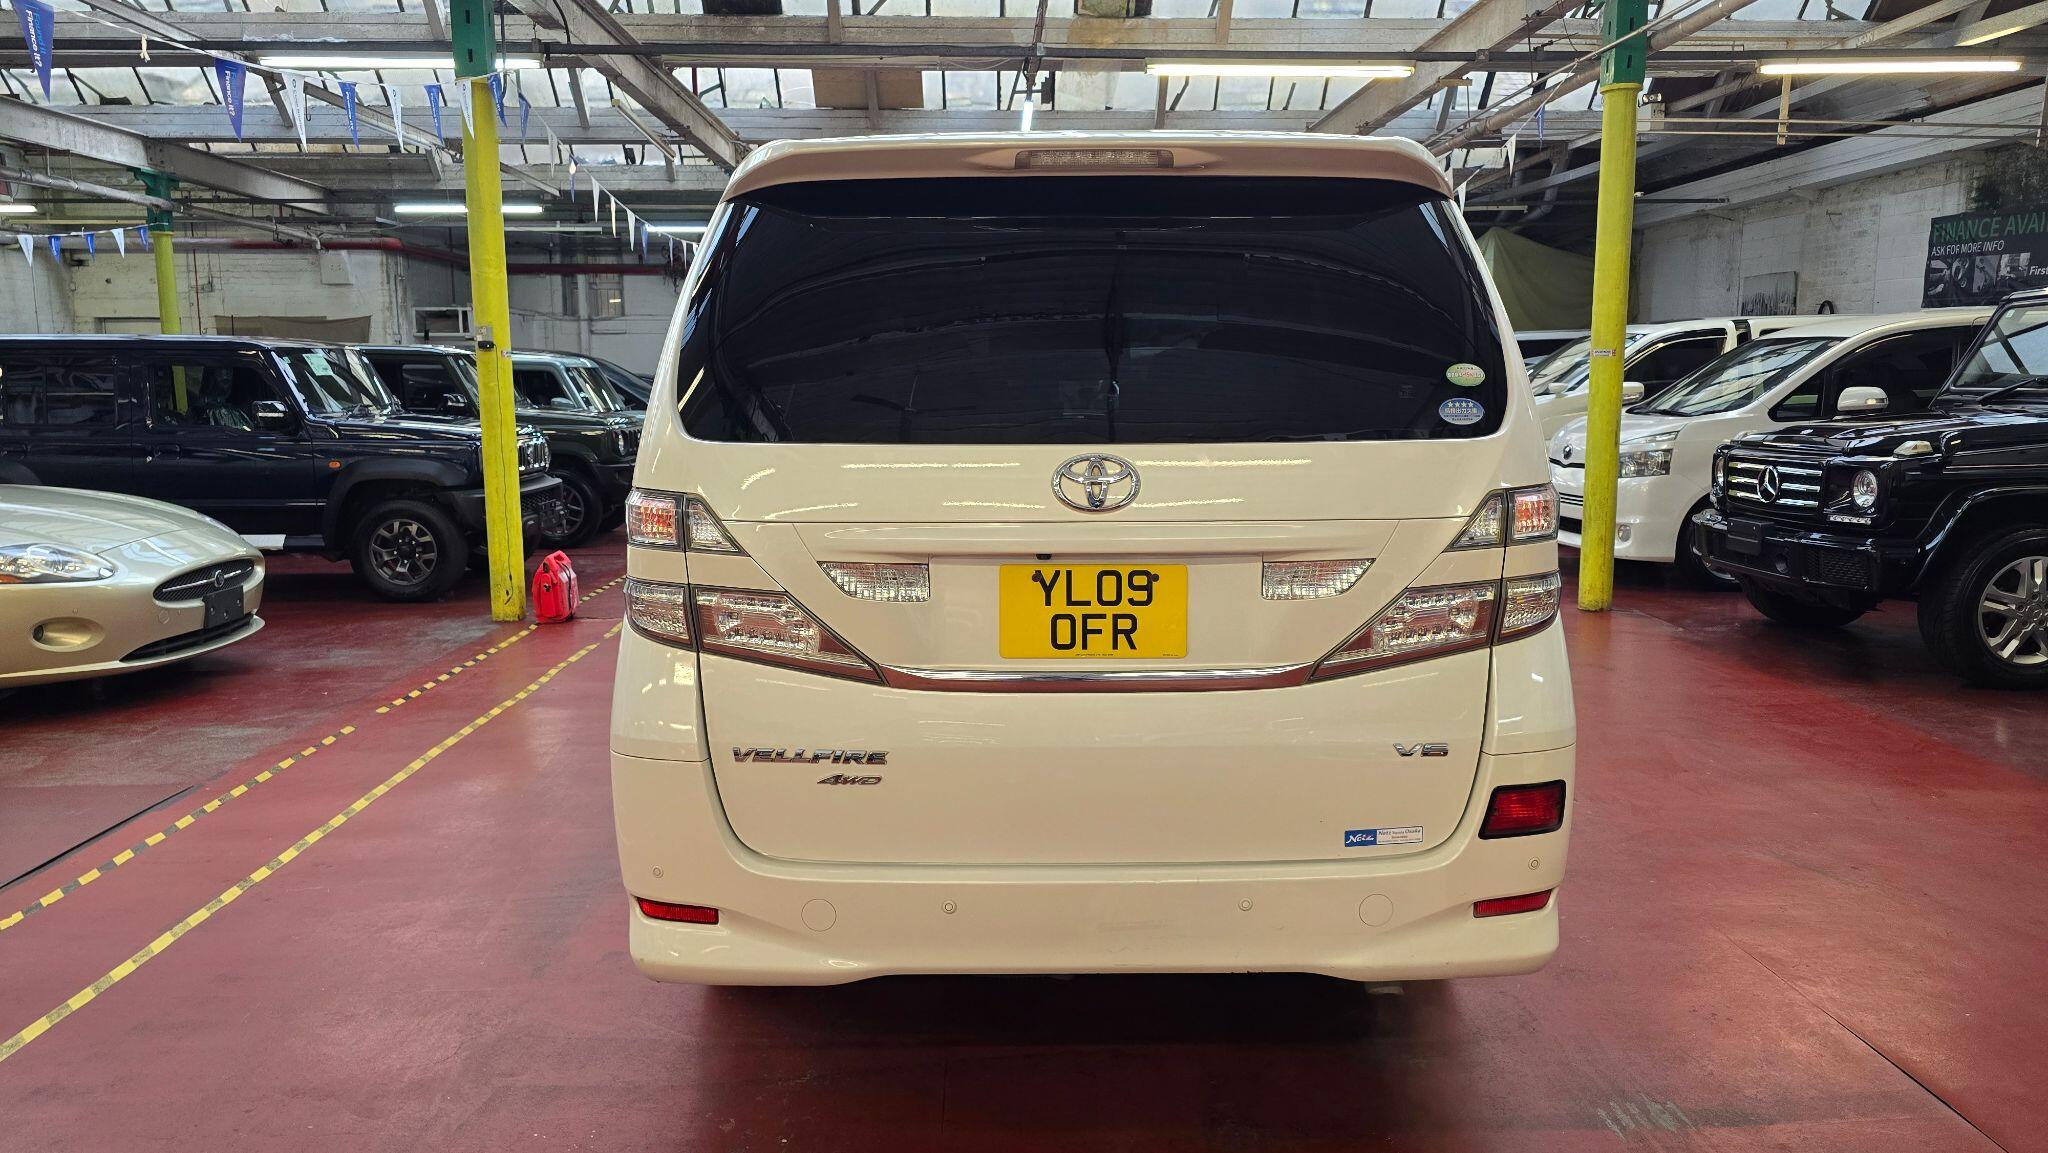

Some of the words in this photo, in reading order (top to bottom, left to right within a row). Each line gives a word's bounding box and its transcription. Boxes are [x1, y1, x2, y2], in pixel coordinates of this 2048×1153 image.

[26, 9, 37, 51] Finance
[1933, 217, 2002, 242] FINANCE
[2004, 211, 2048, 236] AVAI
[1931, 246, 1945, 257] ASK
[1961, 241, 1982, 254] MORE
[1983, 240, 2005, 251] INFO
[1034, 569, 1154, 607] YL09
[1050, 613, 1138, 651] OFR
[732, 747, 889, 765] VELLFIRE
[816, 772, 883, 786] 4WD
